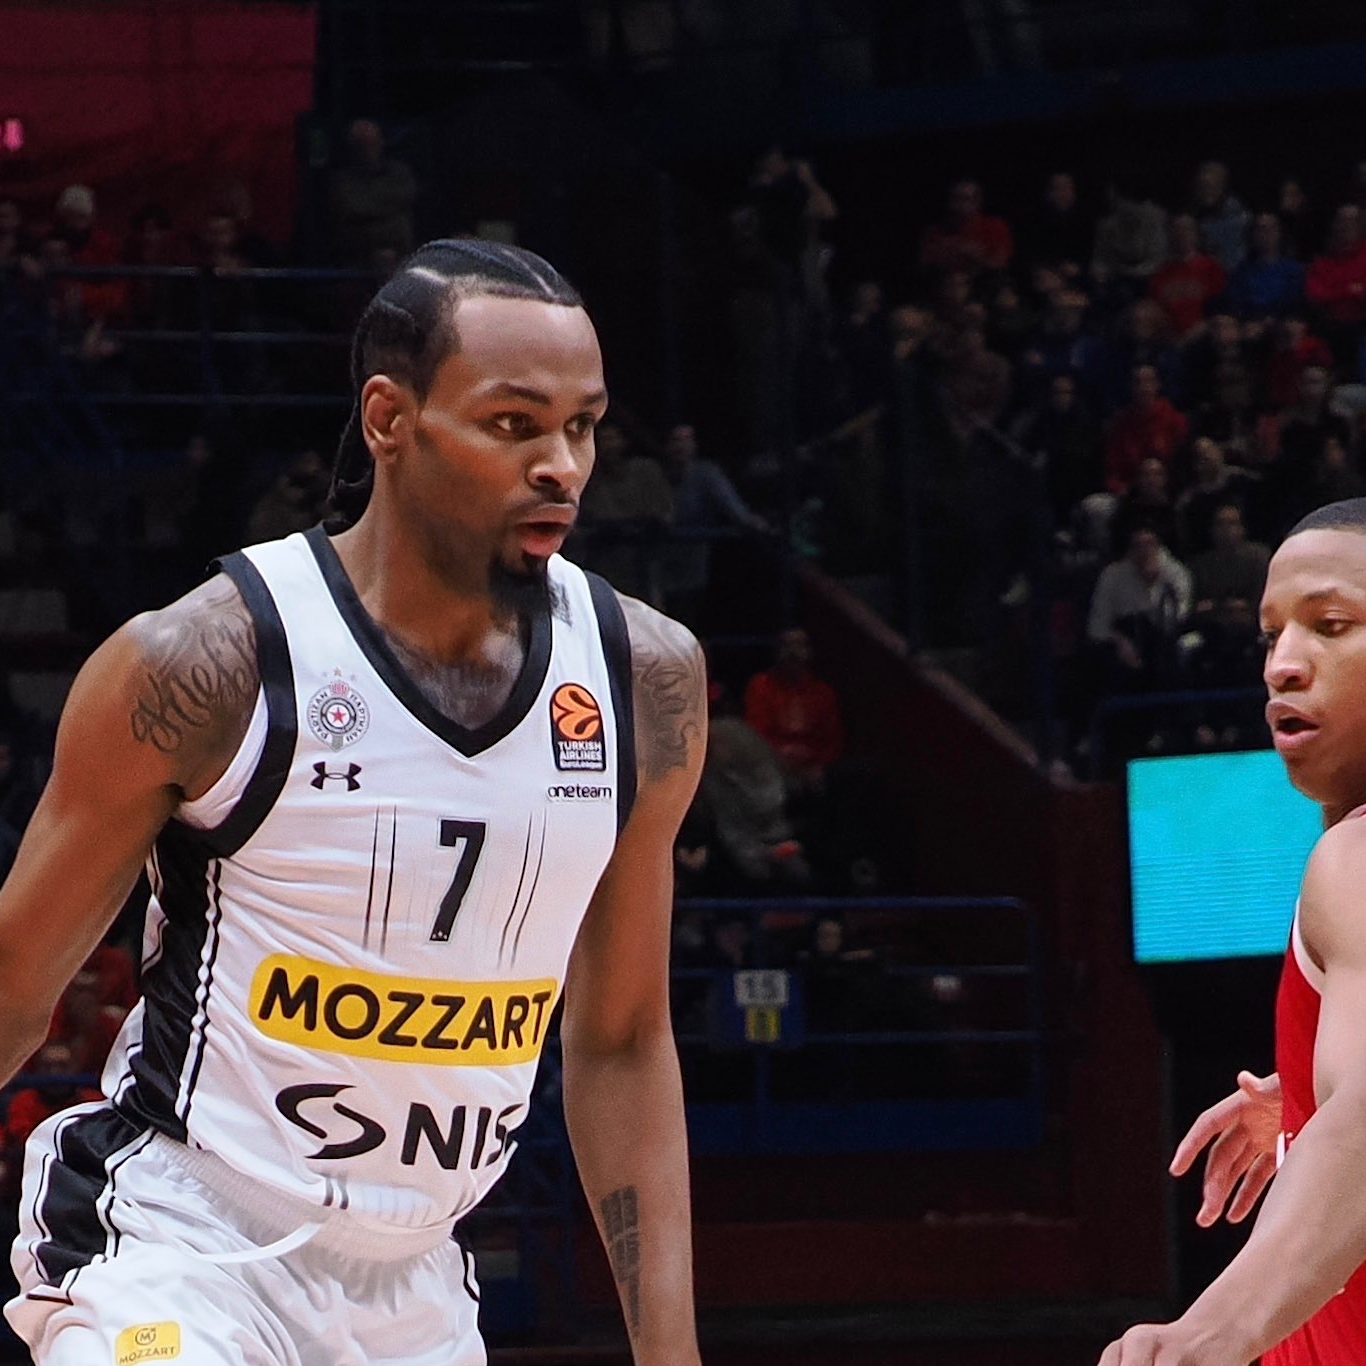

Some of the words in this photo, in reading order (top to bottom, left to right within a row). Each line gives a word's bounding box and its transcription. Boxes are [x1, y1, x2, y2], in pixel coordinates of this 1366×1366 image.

[557, 741, 603, 751] TURKISH
[559, 750, 603, 760] AIRLINES
[548, 784, 612, 798] oneteam
[429, 819, 487, 942] 7
[258, 967, 552, 1051] MOZZART
[119, 1346, 175, 1365] MOZZART
